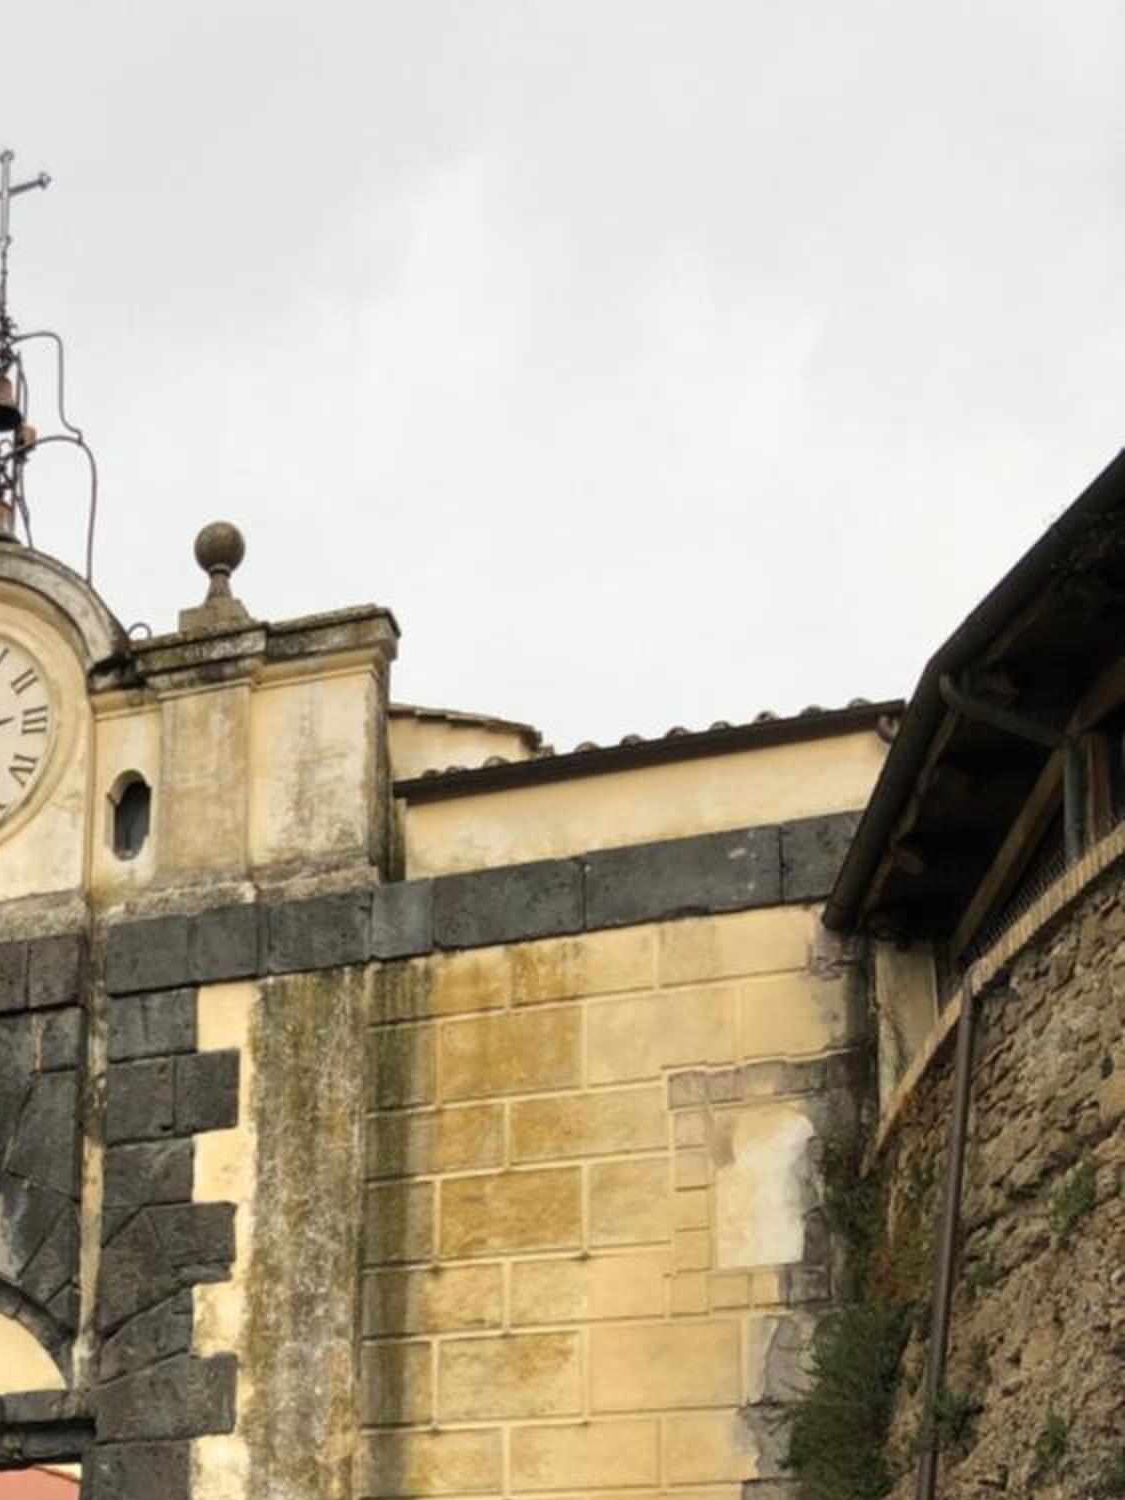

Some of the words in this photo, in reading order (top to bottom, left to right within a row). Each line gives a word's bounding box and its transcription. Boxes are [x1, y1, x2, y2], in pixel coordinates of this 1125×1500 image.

[10, 668, 38, 695] II
[21, 705, 49, 735] III
[8, 753, 37, 787] IV
